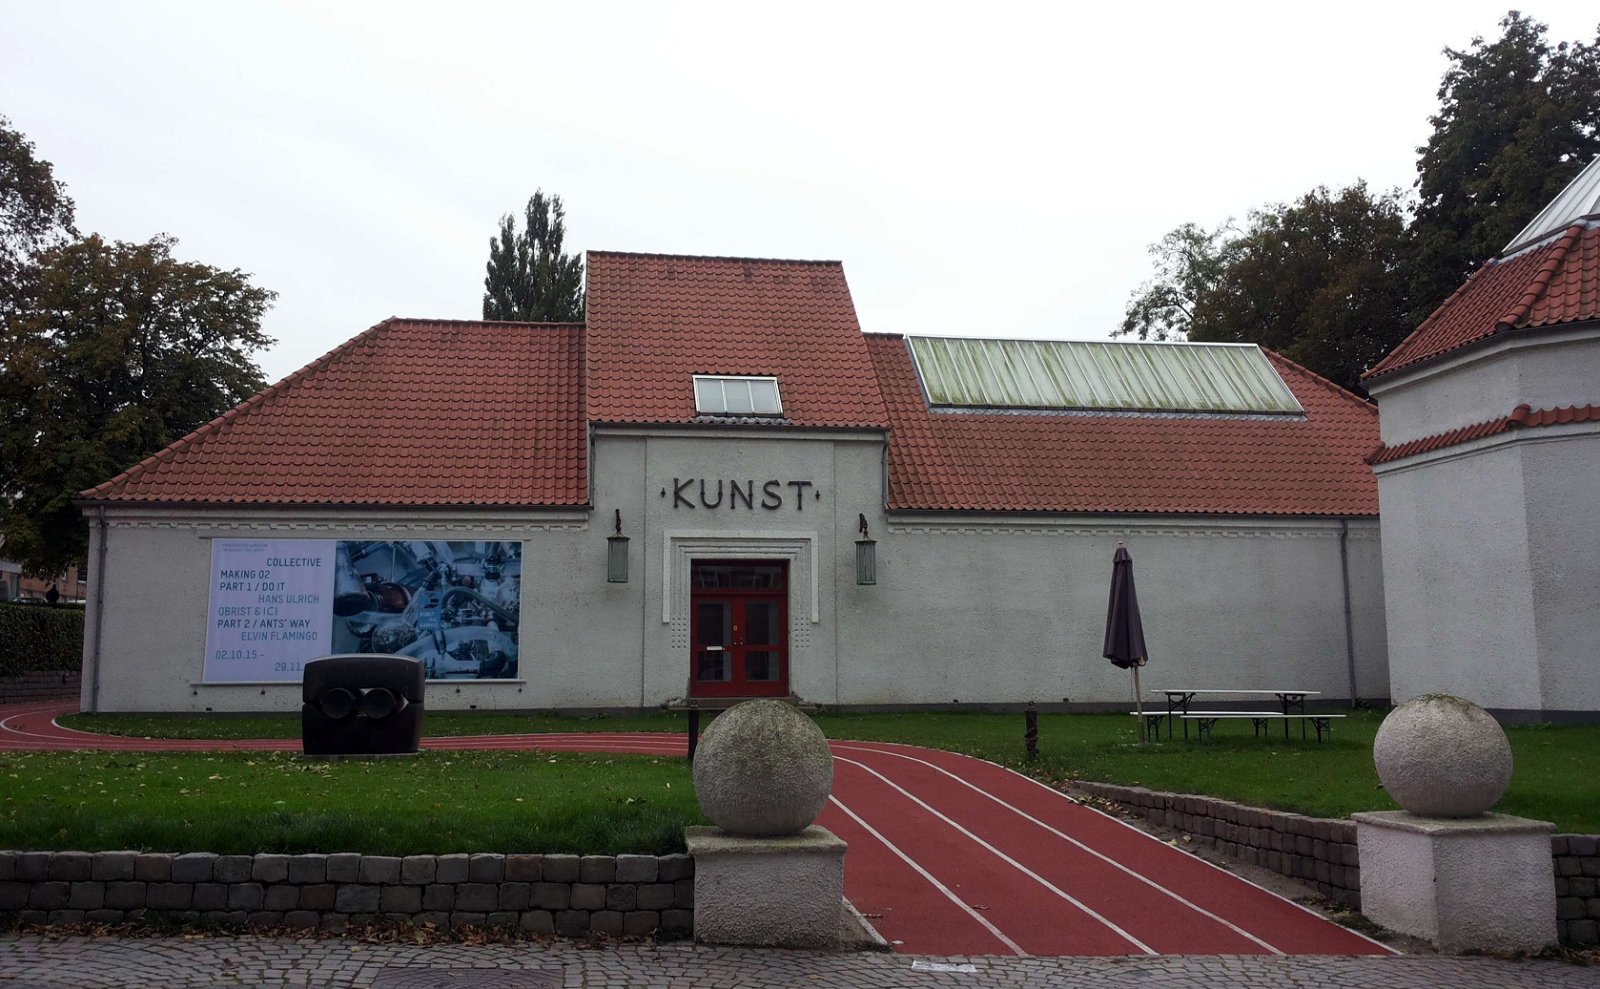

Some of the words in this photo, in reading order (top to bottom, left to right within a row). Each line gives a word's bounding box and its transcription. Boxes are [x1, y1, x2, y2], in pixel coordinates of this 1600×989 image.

[673, 478, 813, 511] KUNST
[267, 557, 322, 567] COLLECTIVE
[220, 570, 256, 579] MAKING
[258, 570, 270, 579] 02
[219, 582, 244, 591] PART
[246, 582, 252, 591] 1
[254, 582, 260, 591] /
[262, 582, 275, 592] DO
[277, 582, 285, 591] IT
[258, 594, 284, 604] HANS
[286, 594, 320, 604] ULRICH
[218, 607, 252, 616] OBRIST
[254, 607, 260, 616] &
[217, 619, 242, 629] PART
[244, 619, 250, 628] 2
[252, 619, 258, 629] /
[290, 619, 311, 628] WAY
[241, 631, 268, 641] ELVIN
[270, 631, 318, 641] FLAMINGO
[215, 650, 257, 660] 02.10.15
[274, 662, 304, 672] 29.11.
